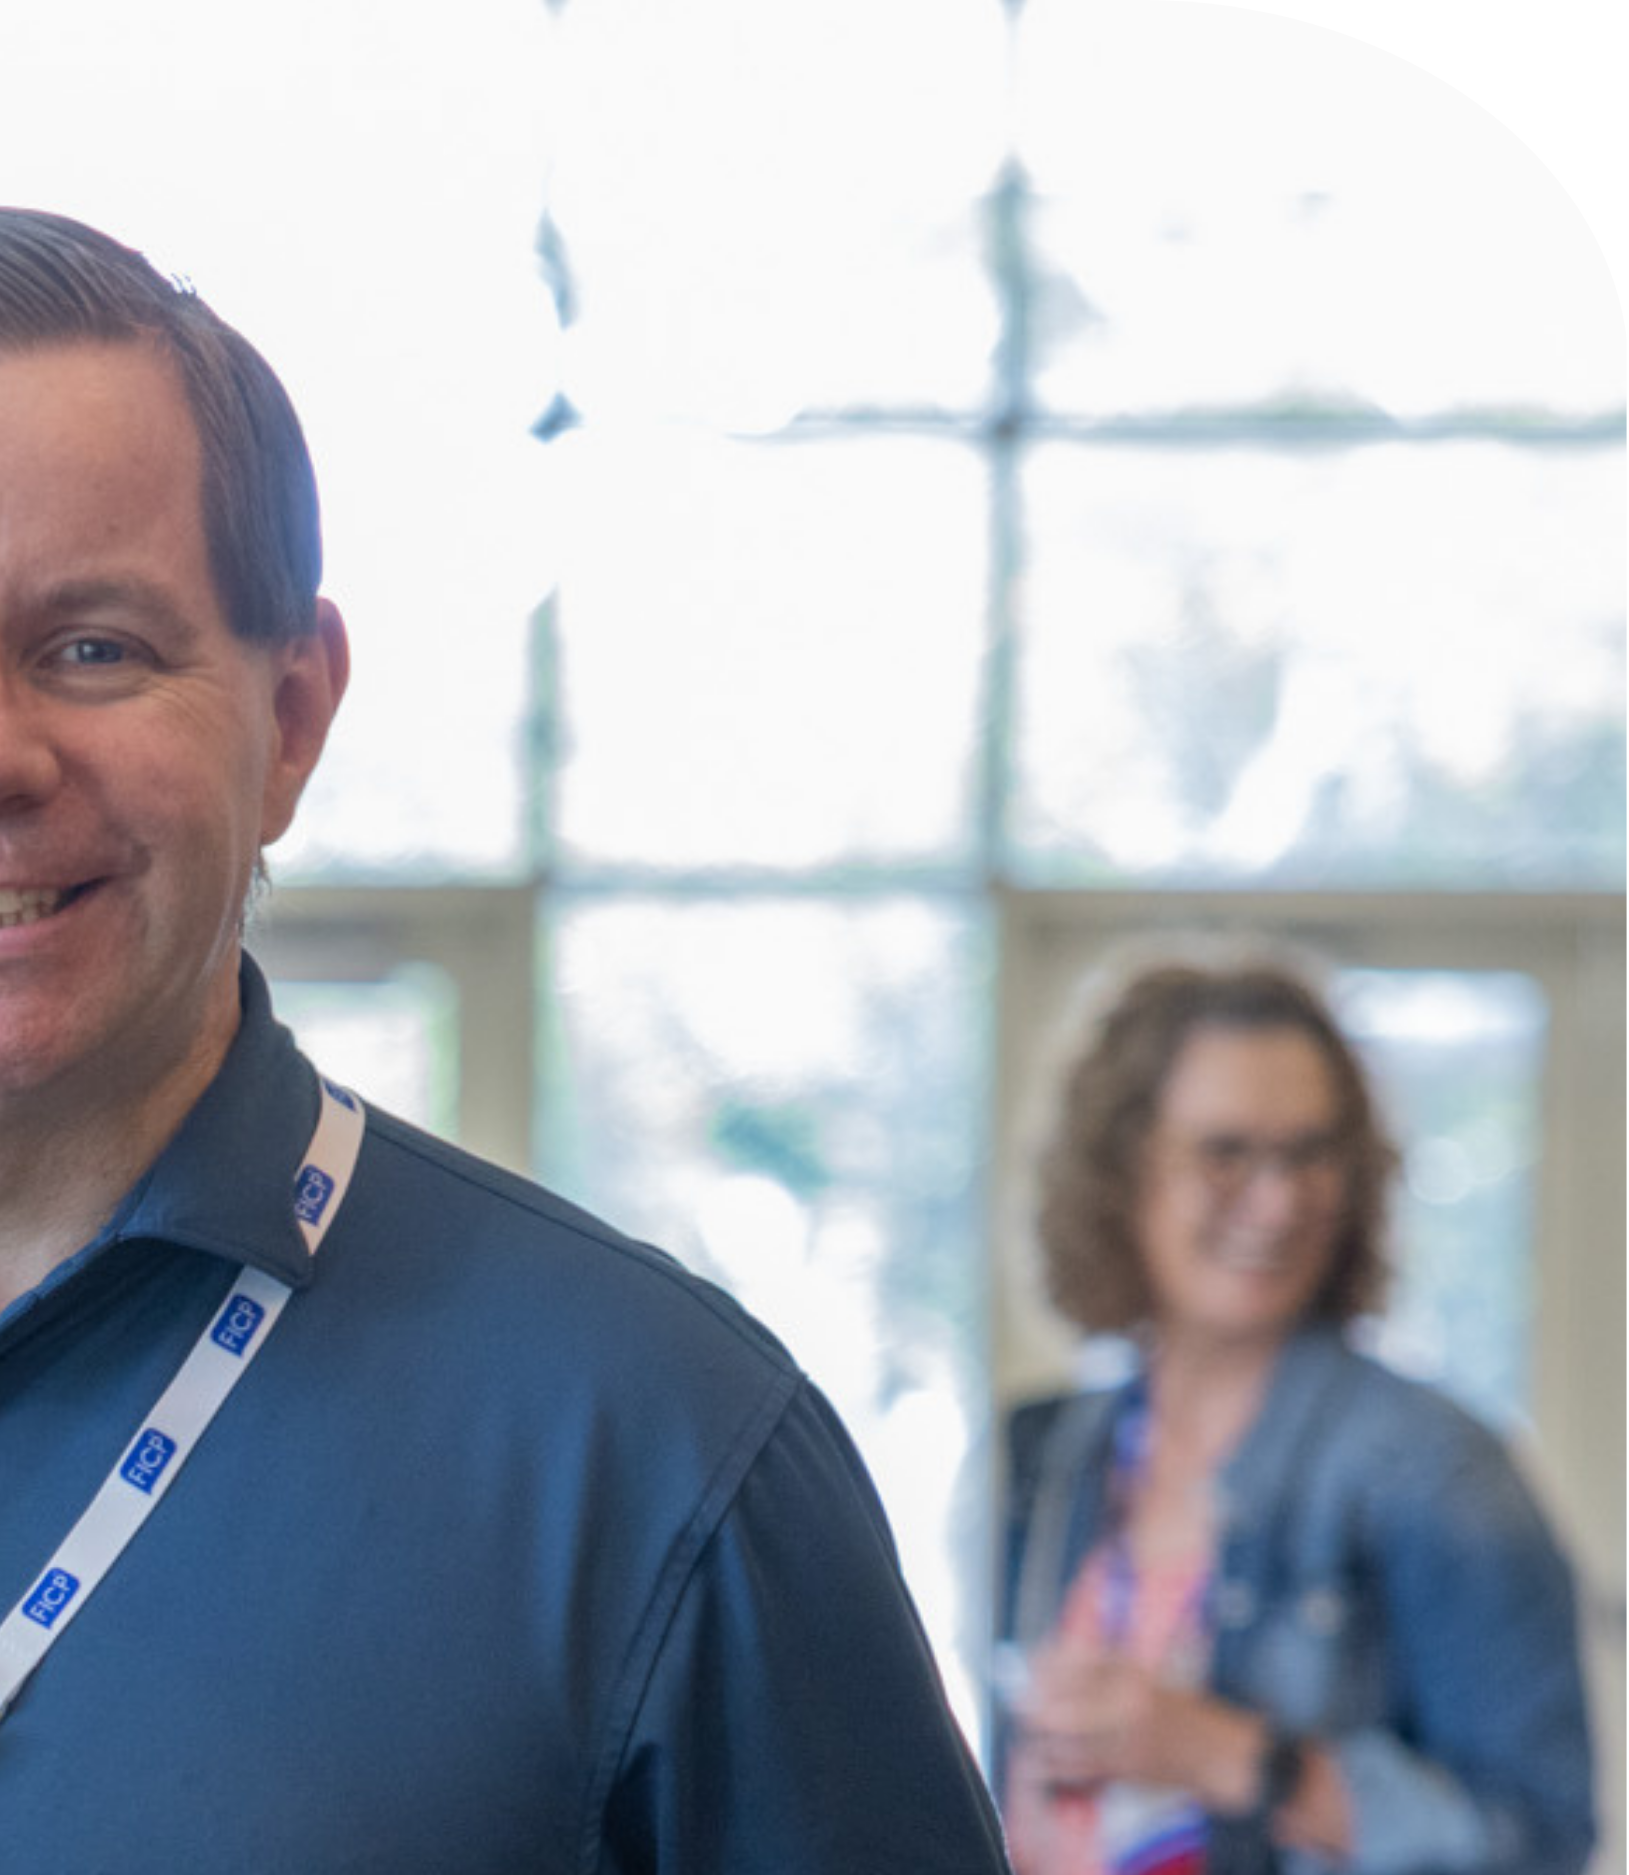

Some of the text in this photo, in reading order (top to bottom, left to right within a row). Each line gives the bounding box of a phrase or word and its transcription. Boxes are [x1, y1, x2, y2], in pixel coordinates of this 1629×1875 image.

[217, 1300, 263, 1352] FICP
[126, 1434, 172, 1487] FICP
[29, 1573, 75, 1626] FICP
